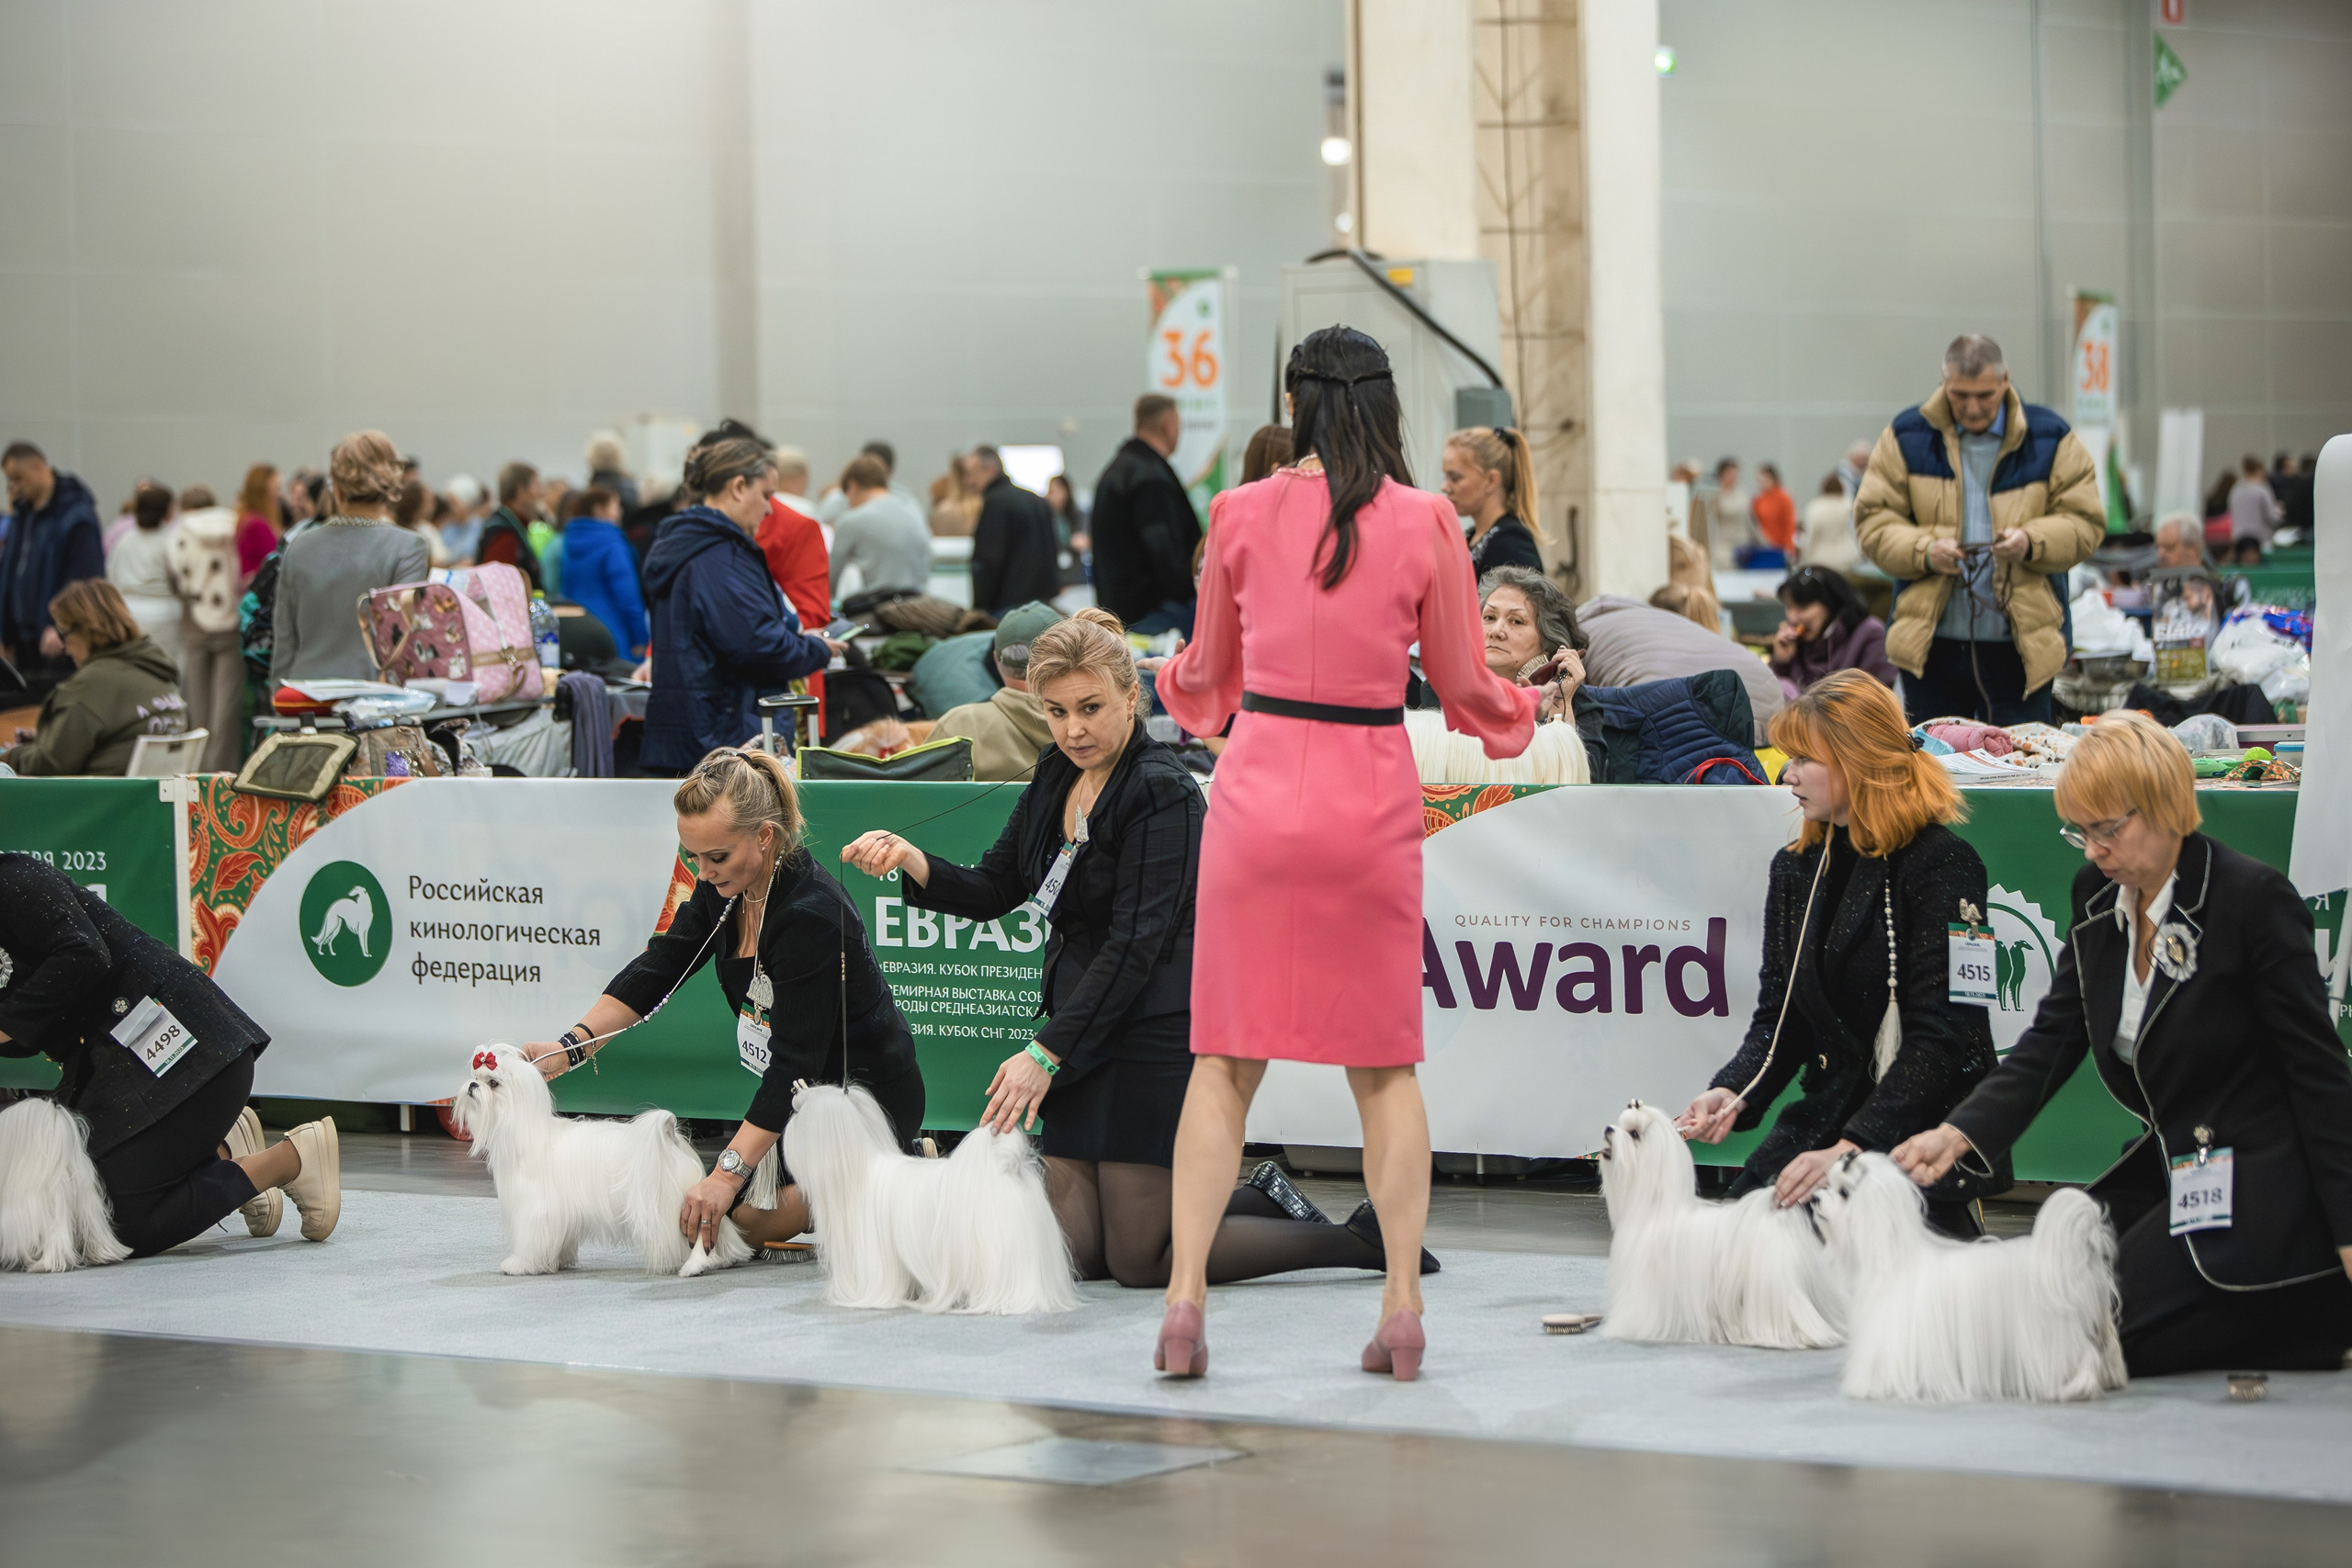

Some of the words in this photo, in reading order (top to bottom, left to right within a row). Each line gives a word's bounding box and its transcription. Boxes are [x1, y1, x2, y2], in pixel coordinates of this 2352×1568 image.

[1161, 329, 1219, 389] 36
[62, 851, 107, 871] 2023
[409, 875, 544, 905] Российская
[410, 920, 602, 947] кинологическая
[876, 896, 1053, 953] ЕВРАЗ
[1454, 915, 1531, 929] QUALITY
[1539, 916, 1573, 929] FOR
[1580, 918, 1691, 931] CHAMPIONS
[412, 952, 542, 987] федерация
[939, 964, 978, 976] КУБОК
[1957, 964, 1991, 982] 4515
[952, 987, 1016, 1002] ВЫСТАВКА
[893, 999, 928, 1014] РОДЫ
[146, 1024, 181, 1061] 4498
[939, 1025, 978, 1039] КУБОК
[980, 1027, 1005, 1039] СНГ
[741, 1040, 767, 1065] 4512
[2177, 1187, 2222, 1210] 4518
